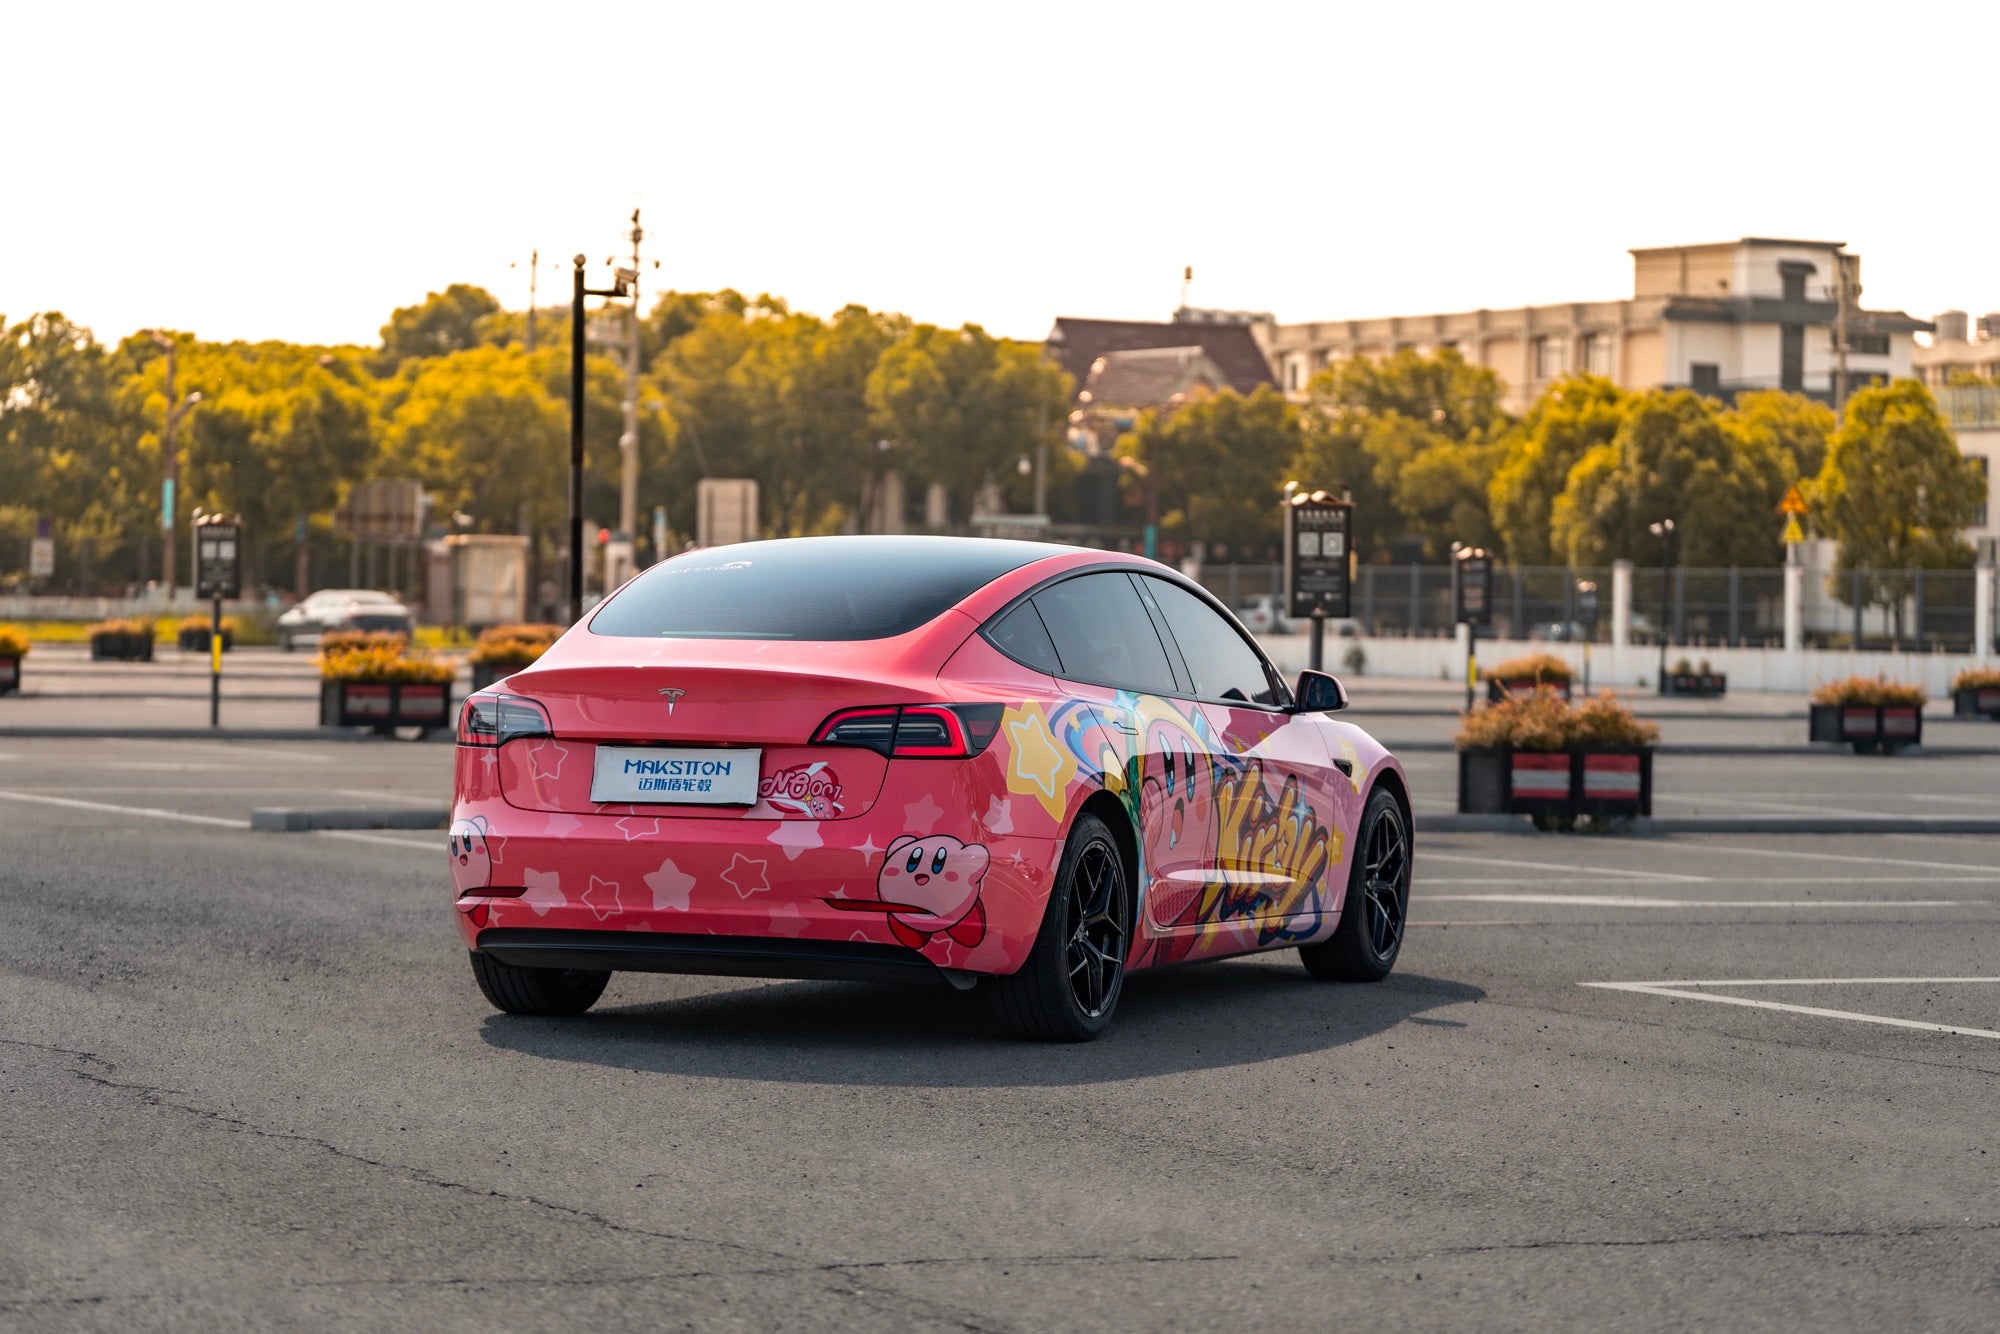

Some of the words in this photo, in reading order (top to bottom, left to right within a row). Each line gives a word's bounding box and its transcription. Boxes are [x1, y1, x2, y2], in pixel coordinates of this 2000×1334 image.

[638, 777, 712, 792] 迈斯盾轮毂
